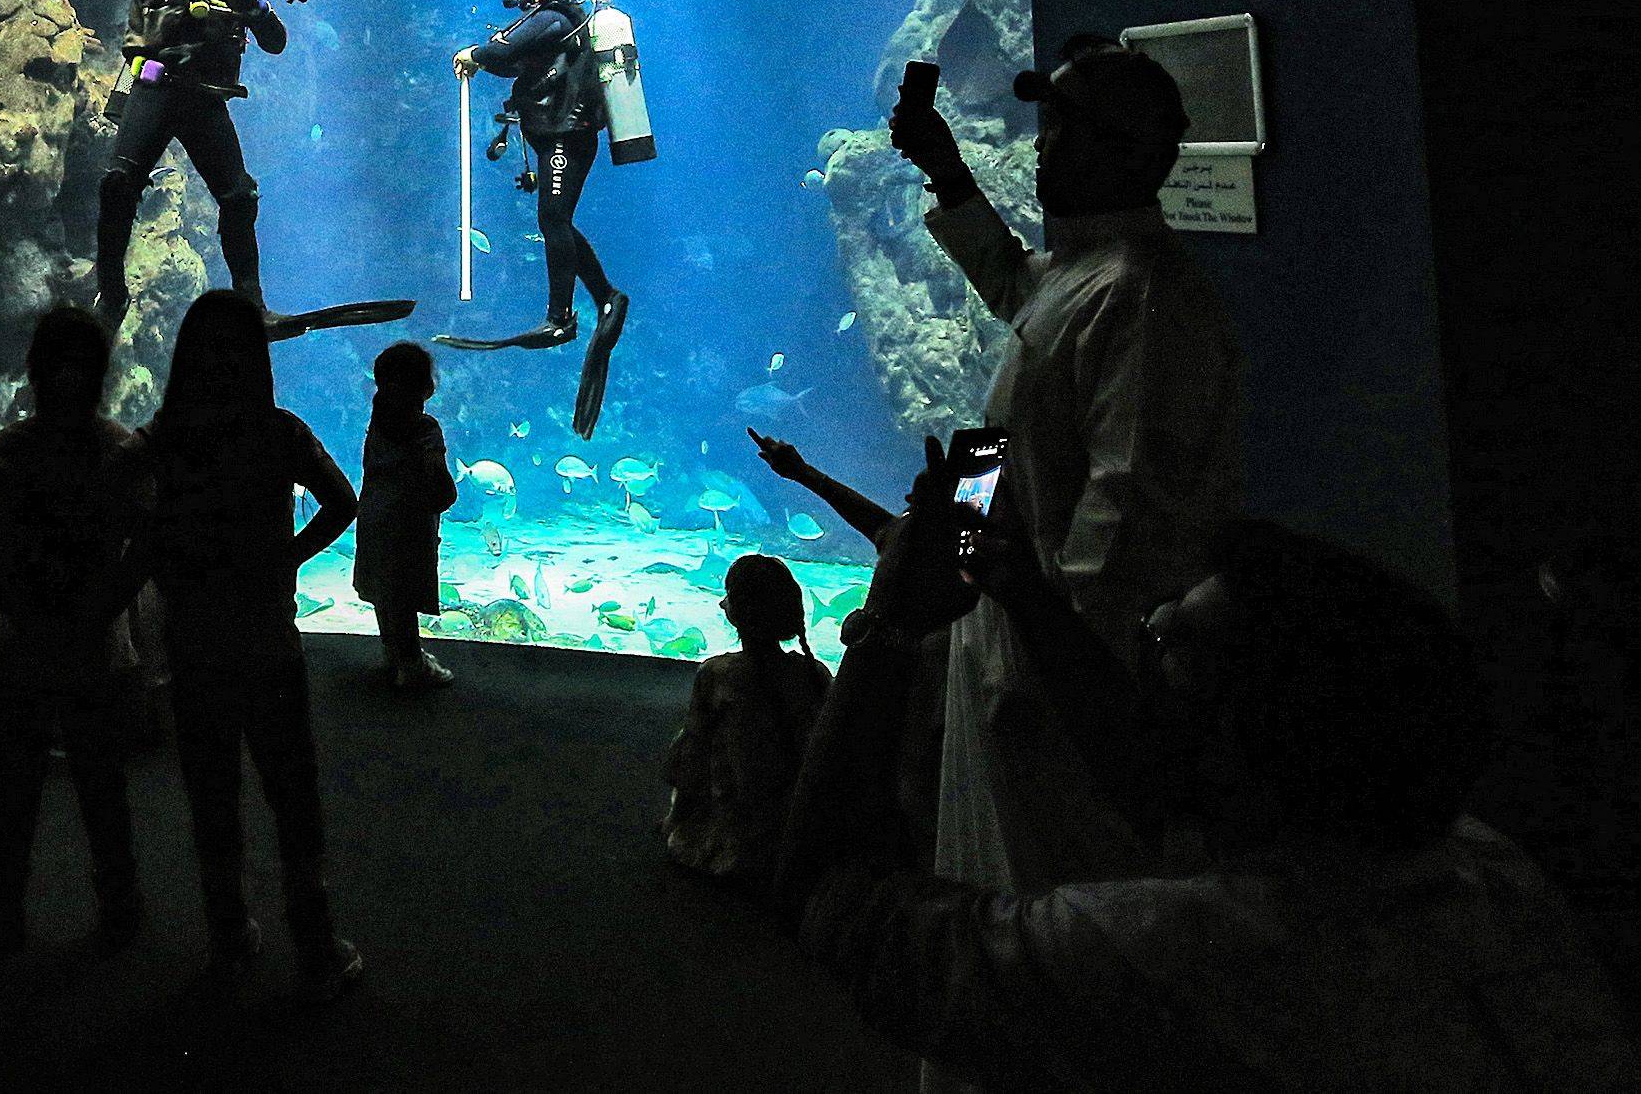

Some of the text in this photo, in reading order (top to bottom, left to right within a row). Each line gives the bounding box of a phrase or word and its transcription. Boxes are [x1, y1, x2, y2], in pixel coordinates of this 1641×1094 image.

[552, 170, 563, 195] LUNG
[1186, 197, 1212, 208] Please
[1219, 212, 1253, 223] Window
